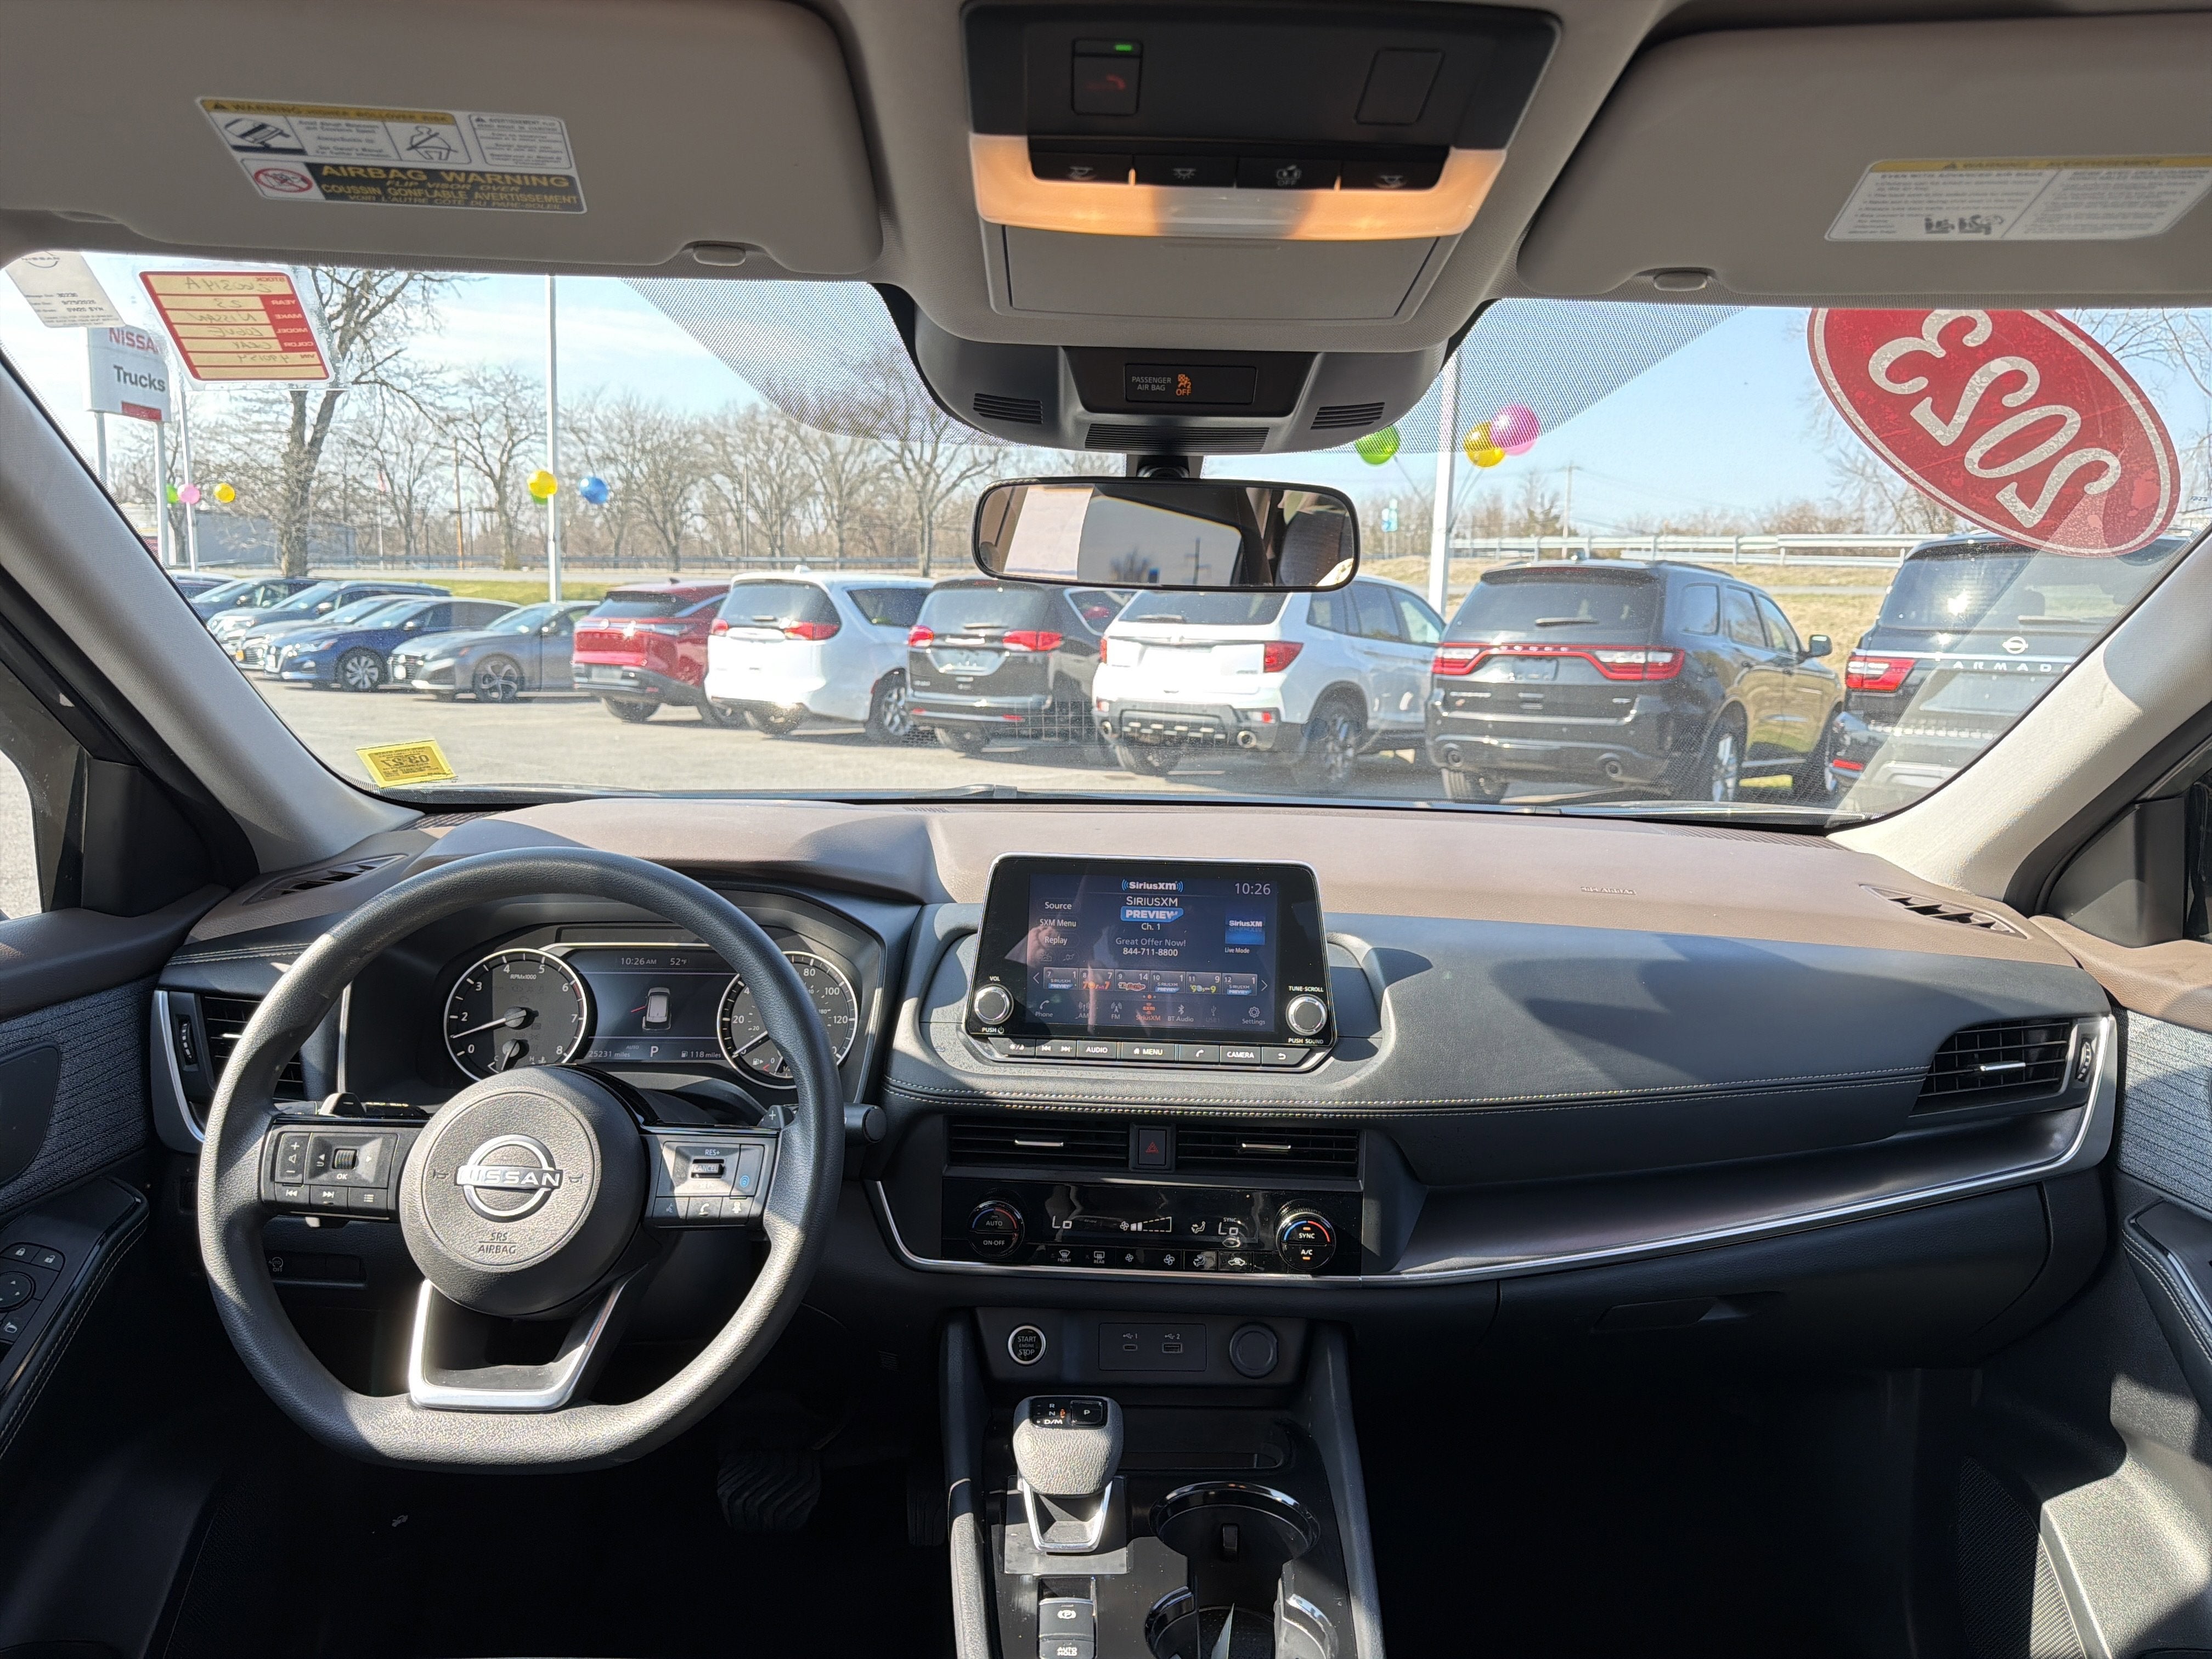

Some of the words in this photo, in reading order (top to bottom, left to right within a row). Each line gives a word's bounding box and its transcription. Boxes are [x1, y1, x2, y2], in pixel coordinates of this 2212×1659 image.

[322, 166, 427, 181] AIRBAG
[441, 171, 570, 188] WARNING
[427, 182, 472, 190] VISOR
[321, 184, 382, 195] COUSSIN
[473, 191, 579, 204] AVERTISSEMENT
[109, 328, 160, 355] NISSA
[113, 365, 166, 392] Trucks
[1234, 883, 1271, 895] 10:26
[1045, 901, 1072, 910] Source
[1126, 910, 1178, 919] PREVIEW
[1040, 918, 1056, 927] SXM
[1057, 919, 1076, 927] Menu
[1045, 936, 1068, 946] Replay
[1115, 937, 1138, 945] Great
[1140, 938, 1163, 946] Offer
[1165, 939, 1186, 947] Now!
[1122, 947, 1178, 956] 844-711-8800
[503, 964, 510, 973] 4
[538, 964, 545, 974] 5
[803, 968, 816, 977] 80
[475, 981, 482, 991] 3
[562, 983, 569, 992] 6
[825, 987, 840, 996] 100
[461, 1012, 468, 1022] 2
[571, 1014, 578, 1023] 7
[732, 1015, 744, 1024] 20
[833, 1015, 848, 1024] 120
[467, 1044, 475, 1053] 0
[556, 1045, 563, 1054] 8
[650, 1046, 658, 1057] P
[460, 1169, 560, 1186] NISSAN
[490, 1232, 508, 1241] SRS
[477, 1244, 516, 1254] AIRBAG
